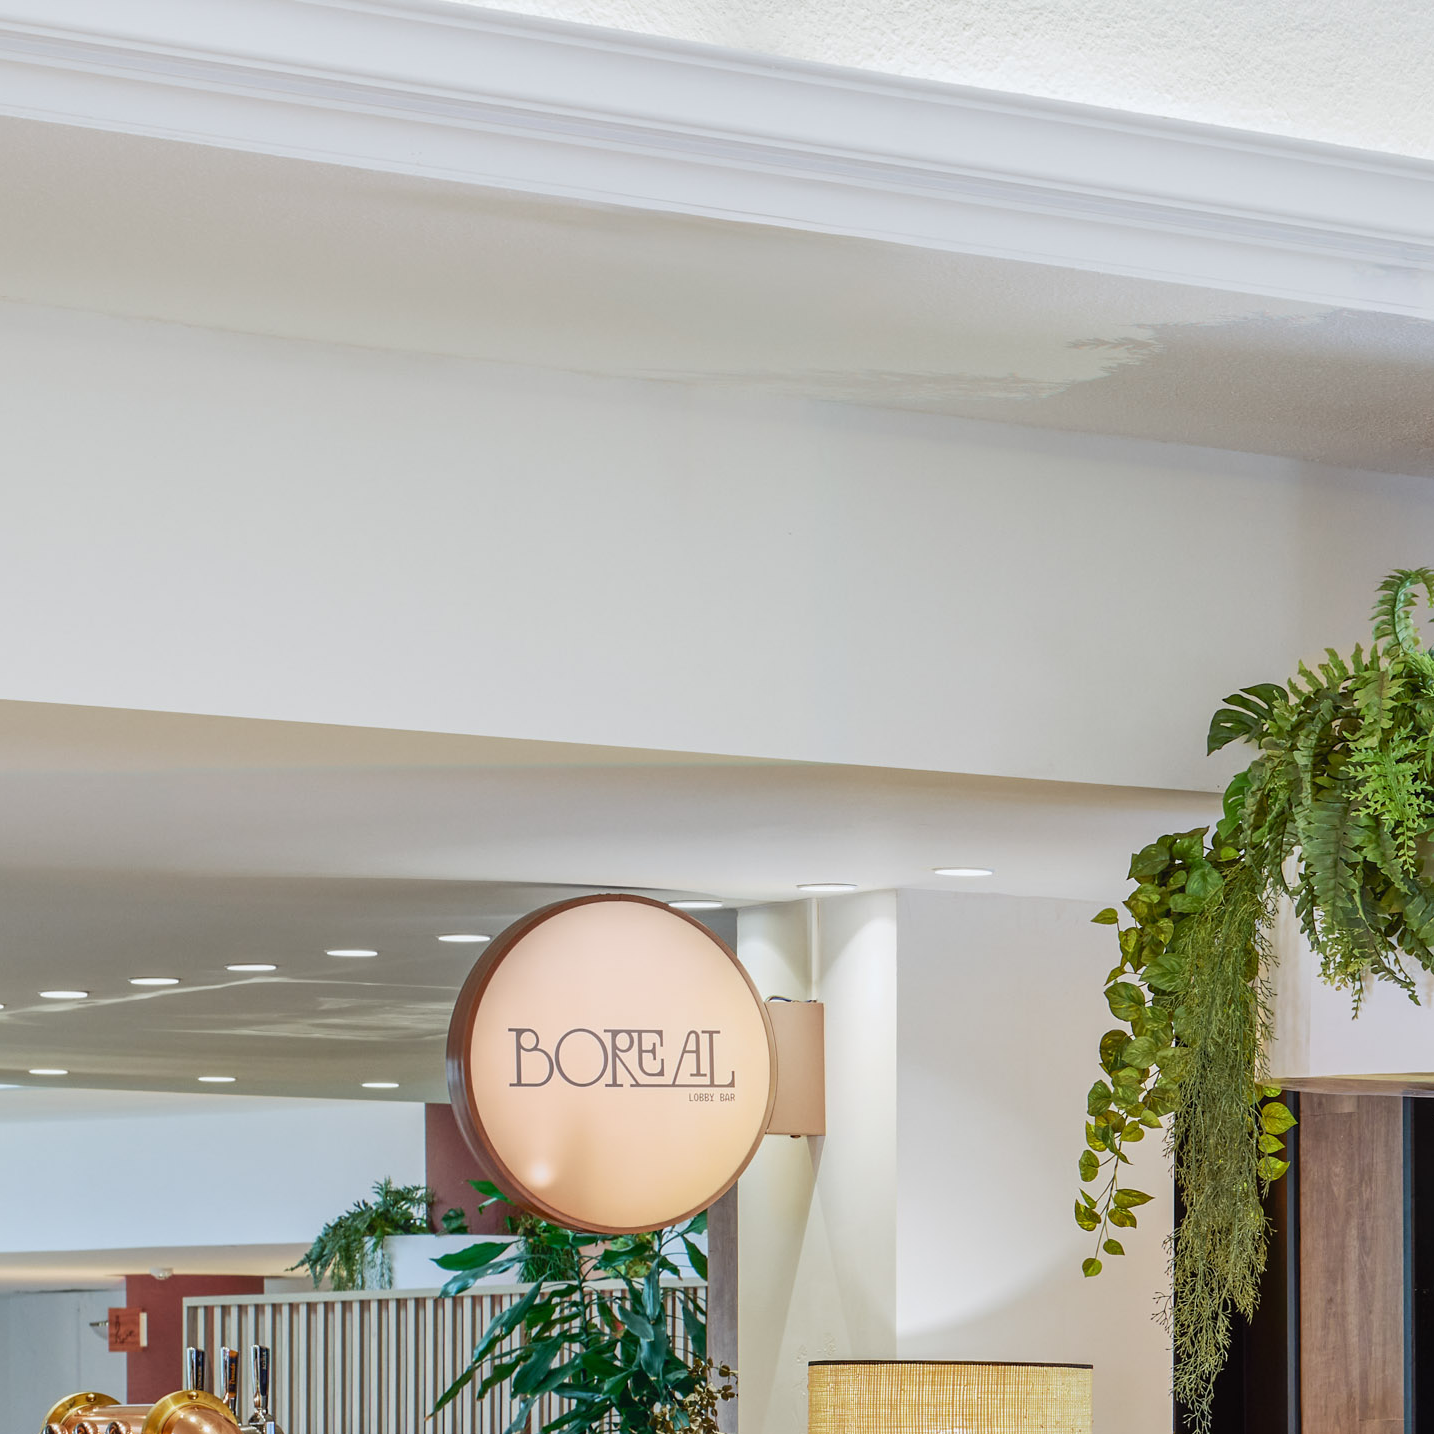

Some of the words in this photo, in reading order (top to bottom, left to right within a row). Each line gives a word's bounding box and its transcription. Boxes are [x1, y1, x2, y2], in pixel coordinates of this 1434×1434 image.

[507, 1027, 736, 1089] BOREAL
[688, 1092, 715, 1102] LOBBY
[719, 1092, 736, 1102] BAR
